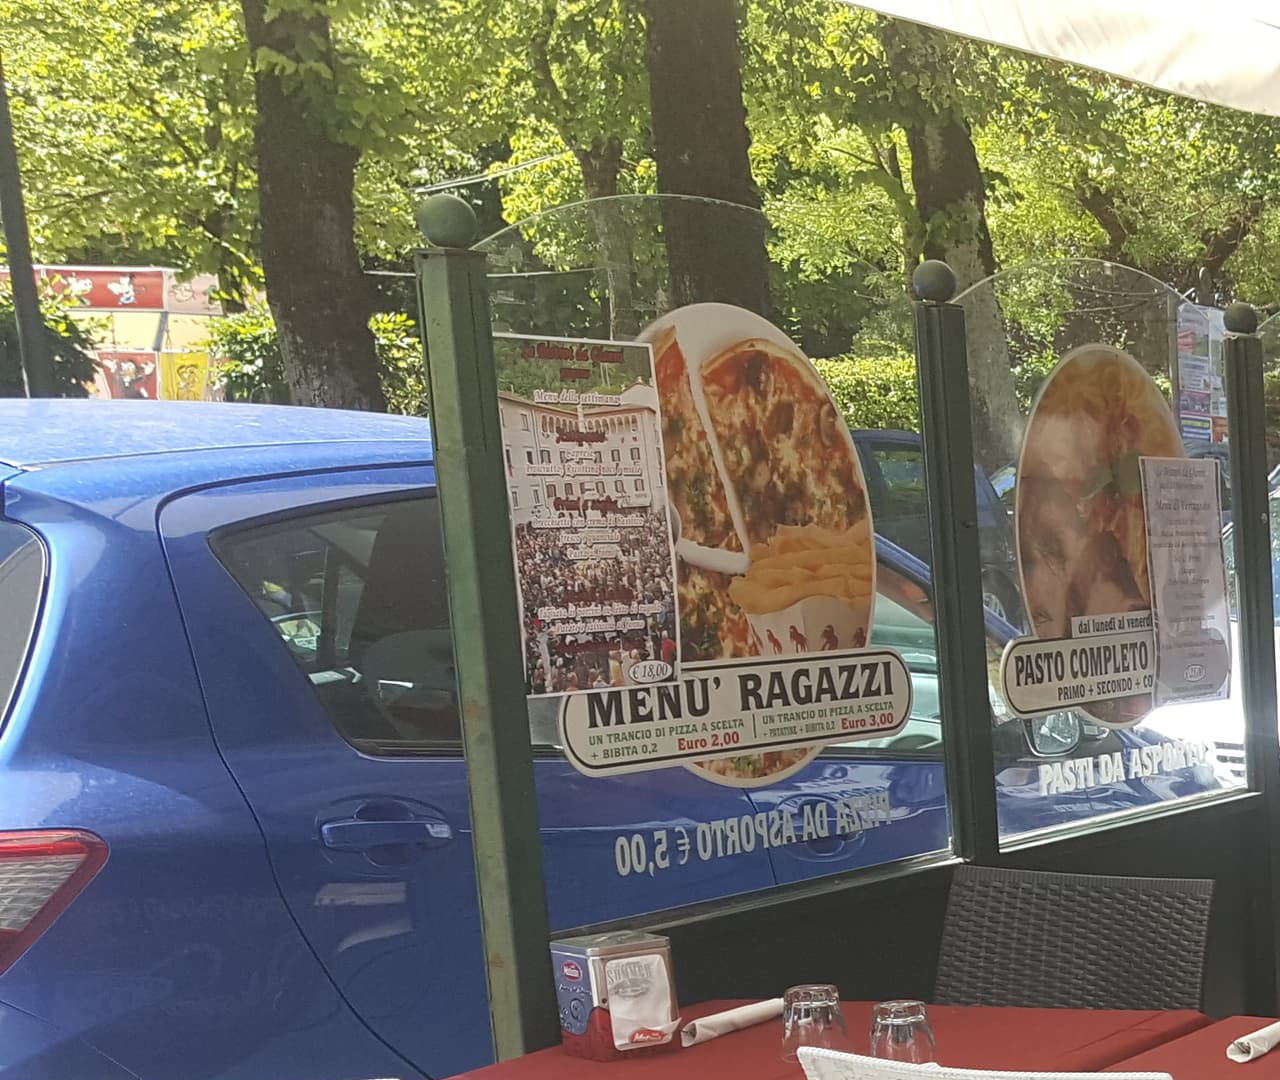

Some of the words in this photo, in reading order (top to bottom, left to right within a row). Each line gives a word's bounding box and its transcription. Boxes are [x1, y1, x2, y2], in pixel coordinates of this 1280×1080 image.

[1078, 620, 1090, 634] dal
[1118, 616, 1125, 630] al
[642, 663, 668, 679] 18,00
[1015, 650, 1064, 687] PASTO
[1070, 641, 1148, 679] COMPLETO
[588, 678, 721, 730] MENU'
[738, 661, 894, 711] RAGAZZI
[1058, 684, 1086, 702] PRIMO
[1096, 678, 1132, 696] SECONDO
[762, 715, 775, 725] UN
[777, 711, 815, 724] TRANCIO
[818, 710, 827, 718] DI
[829, 706, 854, 717] PIZZA
[865, 701, 894, 713] SCELTA
[841, 718, 866, 730] Euro
[869, 712, 894, 727] 3,00
[588, 734, 603, 746] UN
[606, 729, 652, 744] TRANCIO
[655, 727, 666, 738] DI
[669, 724, 698, 737] PIZZA
[701, 722, 708, 733] A
[710, 718, 744, 731] SCELTA
[678, 736, 708, 751] Euro
[710, 733, 740, 749] 2,00
[602, 745, 639, 760] BIBITA
[641, 742, 658, 756] 0,2
[1038, 757, 1095, 797] PASTI
[1100, 752, 1126, 784] DA
